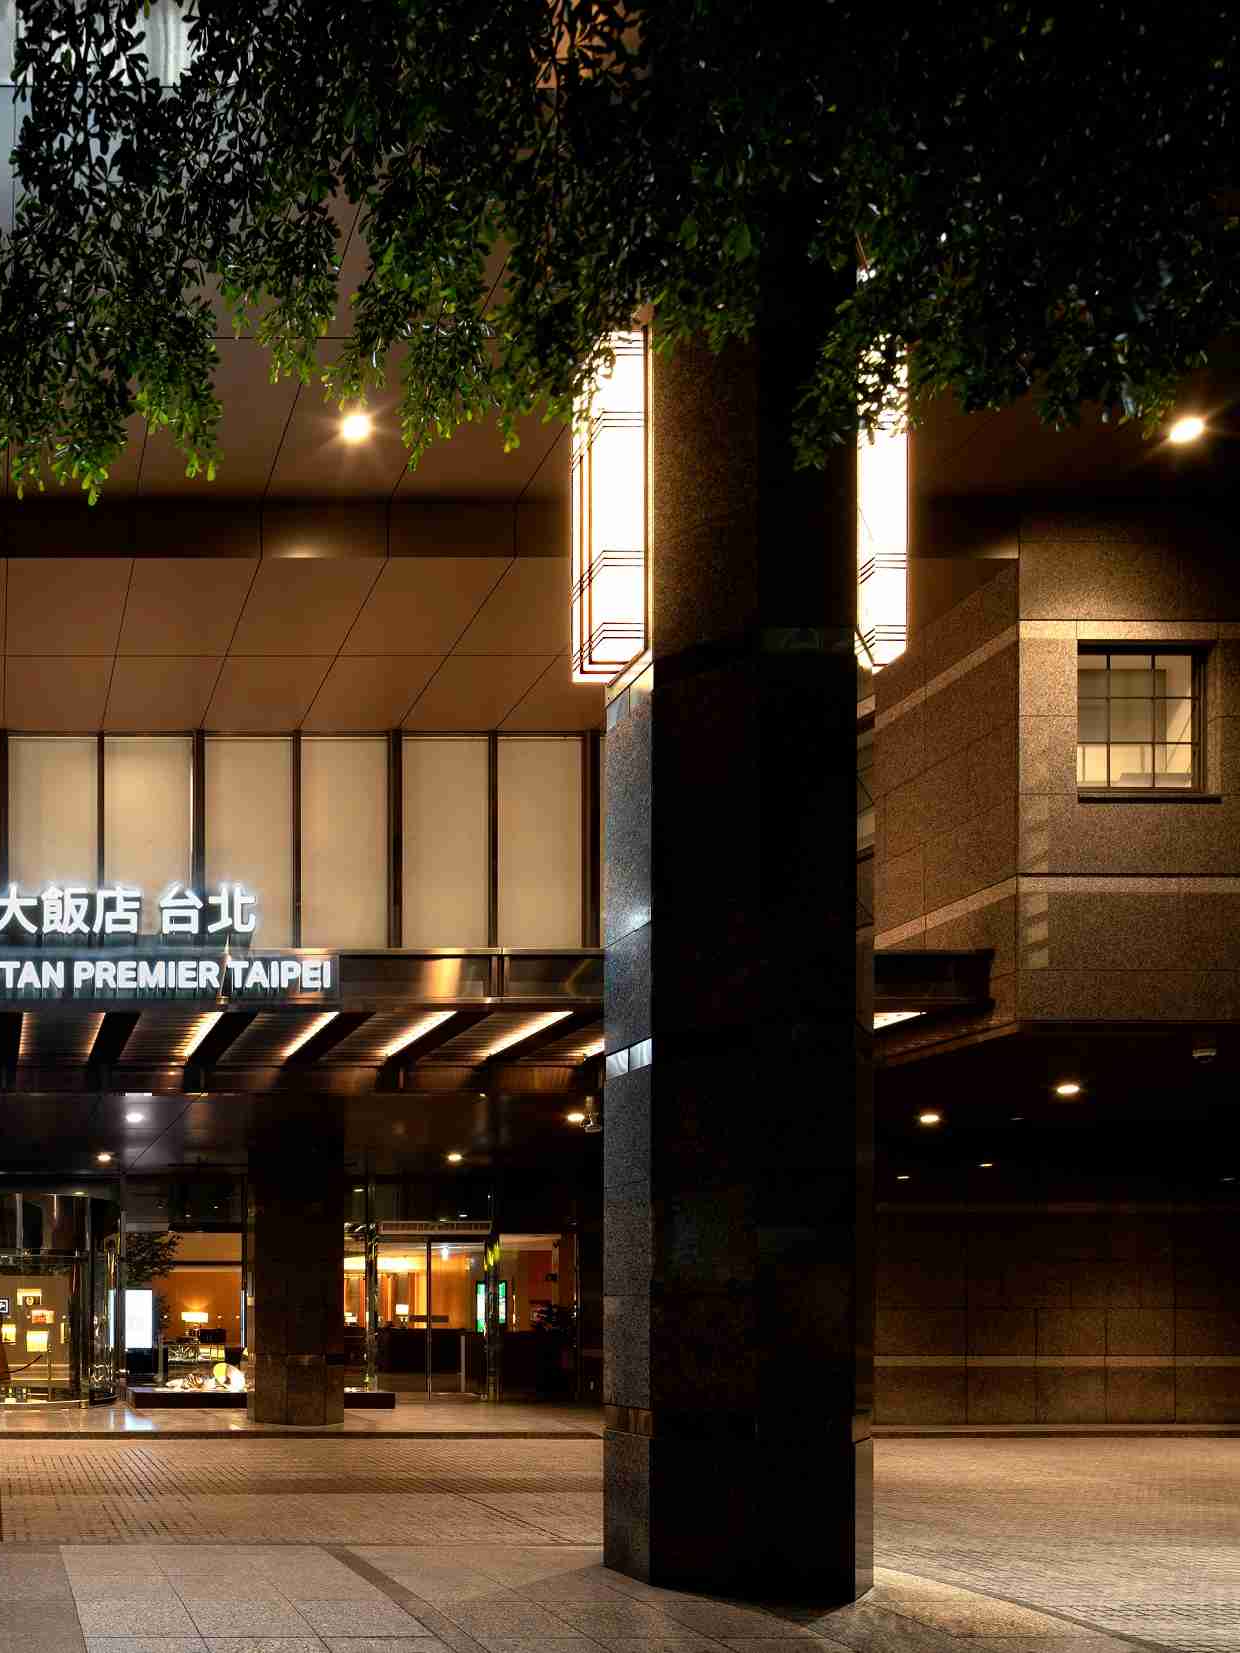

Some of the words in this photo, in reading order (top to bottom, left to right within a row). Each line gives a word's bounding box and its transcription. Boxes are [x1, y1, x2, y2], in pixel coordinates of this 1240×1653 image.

[159, 884, 258, 935] 台北
[72, 960, 221, 989] PREMIER
[227, 960, 331, 989] TAIPEI
